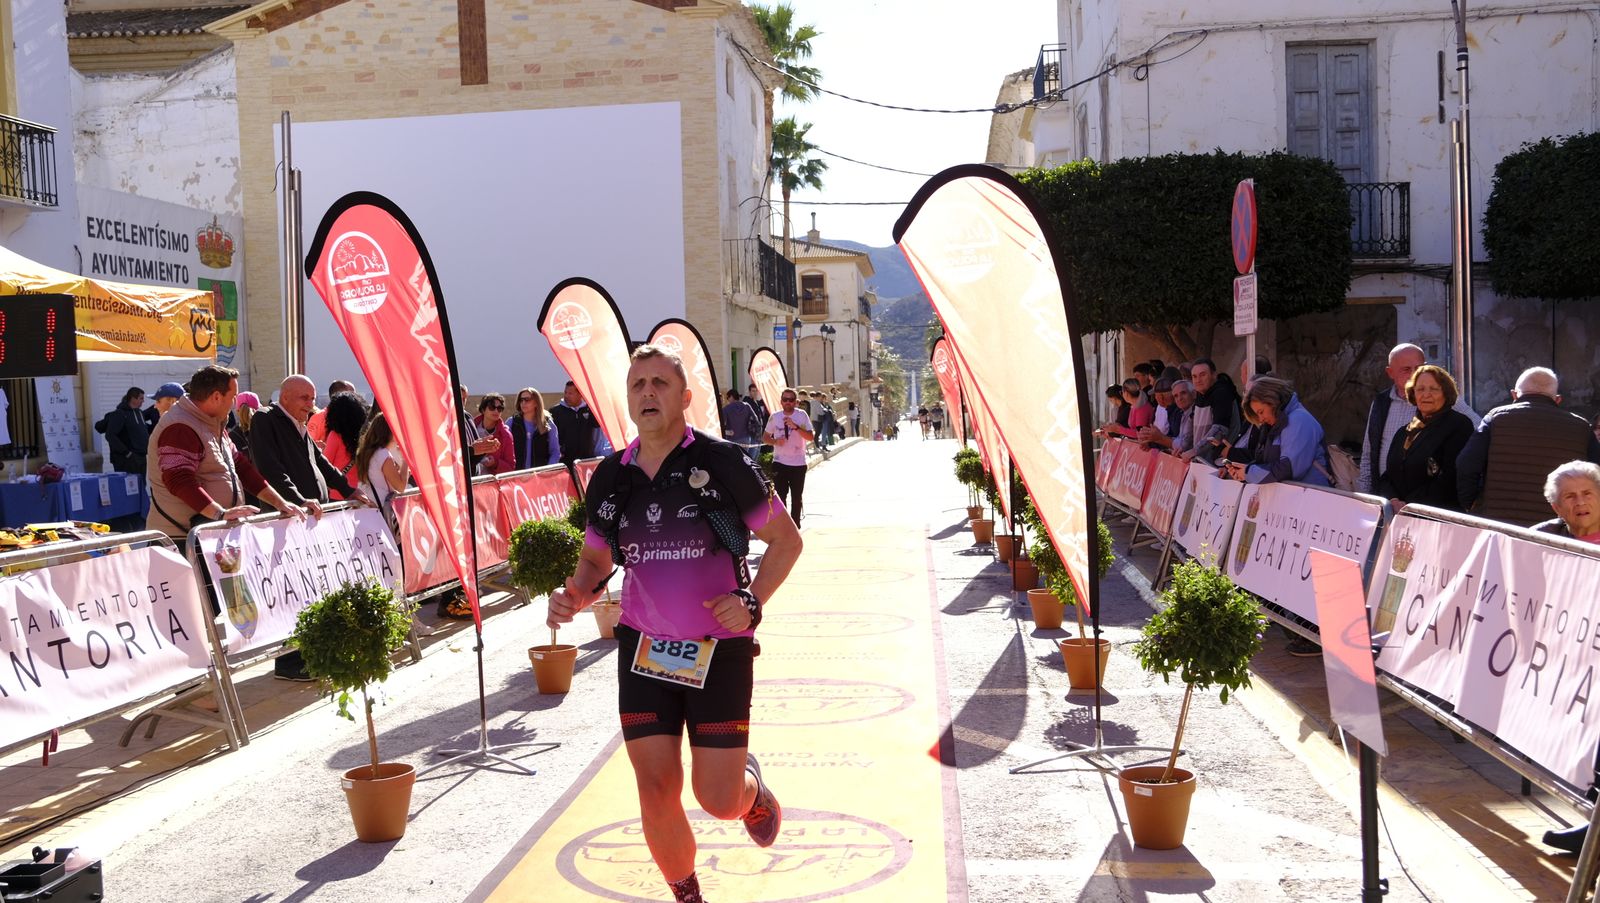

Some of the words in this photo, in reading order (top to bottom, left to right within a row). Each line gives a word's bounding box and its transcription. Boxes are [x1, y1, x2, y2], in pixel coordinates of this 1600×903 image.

[86, 216, 190, 253] EXCELENTÍSIMO
[91, 252, 190, 284] AYUNTAMIENTO
[253, 536, 363, 571] AYUNTAMIENTO
[366, 532, 384, 547] DE
[1264, 511, 1345, 548] AYUNTAMIENTO
[1344, 534, 1363, 556] DE
[642, 547, 706, 564] primaflor
[1253, 531, 1311, 582] CANTO
[149, 581, 173, 604] DE
[261, 551, 394, 609] CANTORIA
[0, 607, 190, 698] NTORIA
[651, 639, 699, 662] 382
